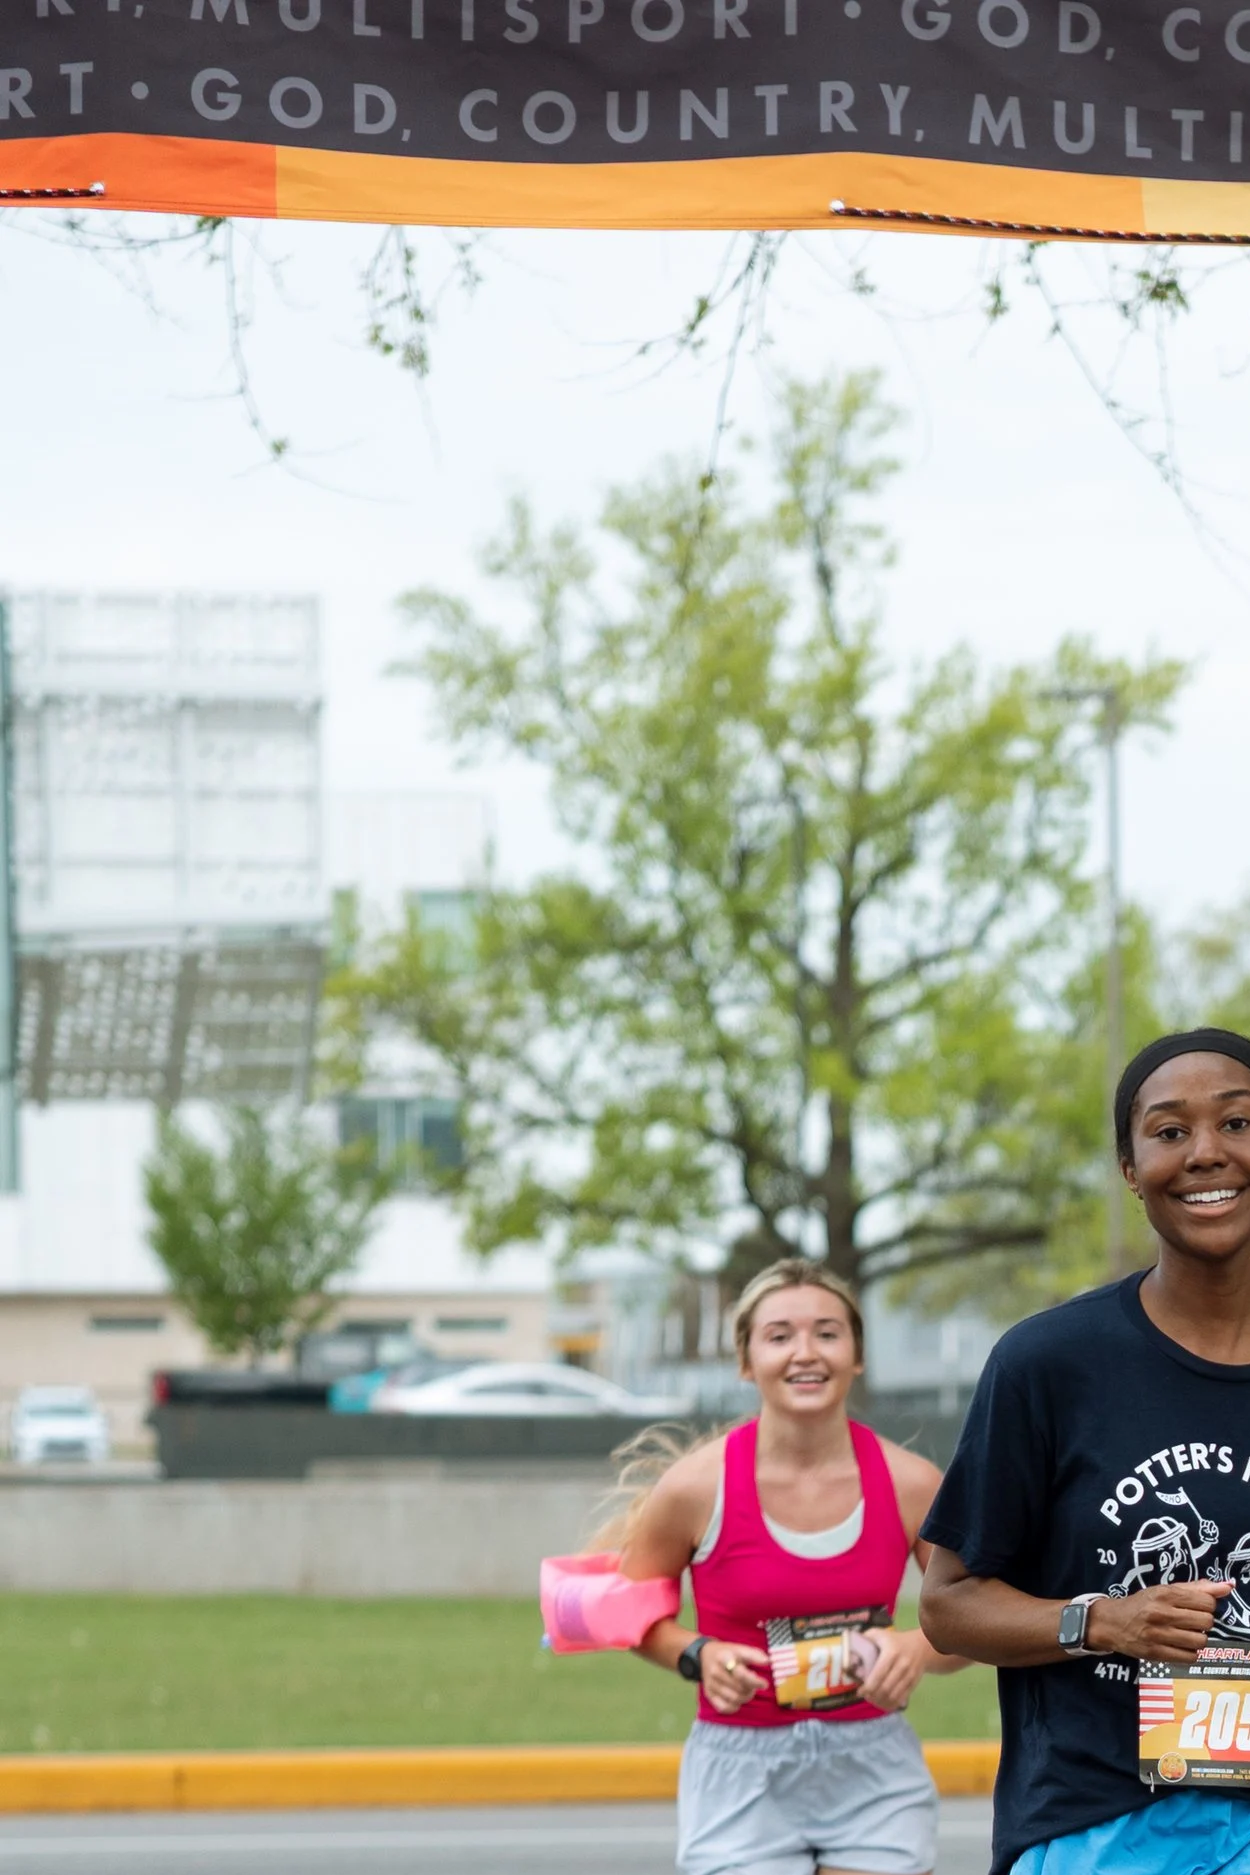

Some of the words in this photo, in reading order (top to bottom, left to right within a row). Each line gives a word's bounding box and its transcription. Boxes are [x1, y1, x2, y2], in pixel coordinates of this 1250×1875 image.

[902, 0, 1114, 60] GOD,
[190, 67, 412, 142] GOD,
[458, 81, 925, 143] COUNTRY,
[1100, 1442, 1234, 1526] POTTER'S
[1097, 1549, 1117, 1565] 20
[1094, 1662, 1130, 1682] 4TH
